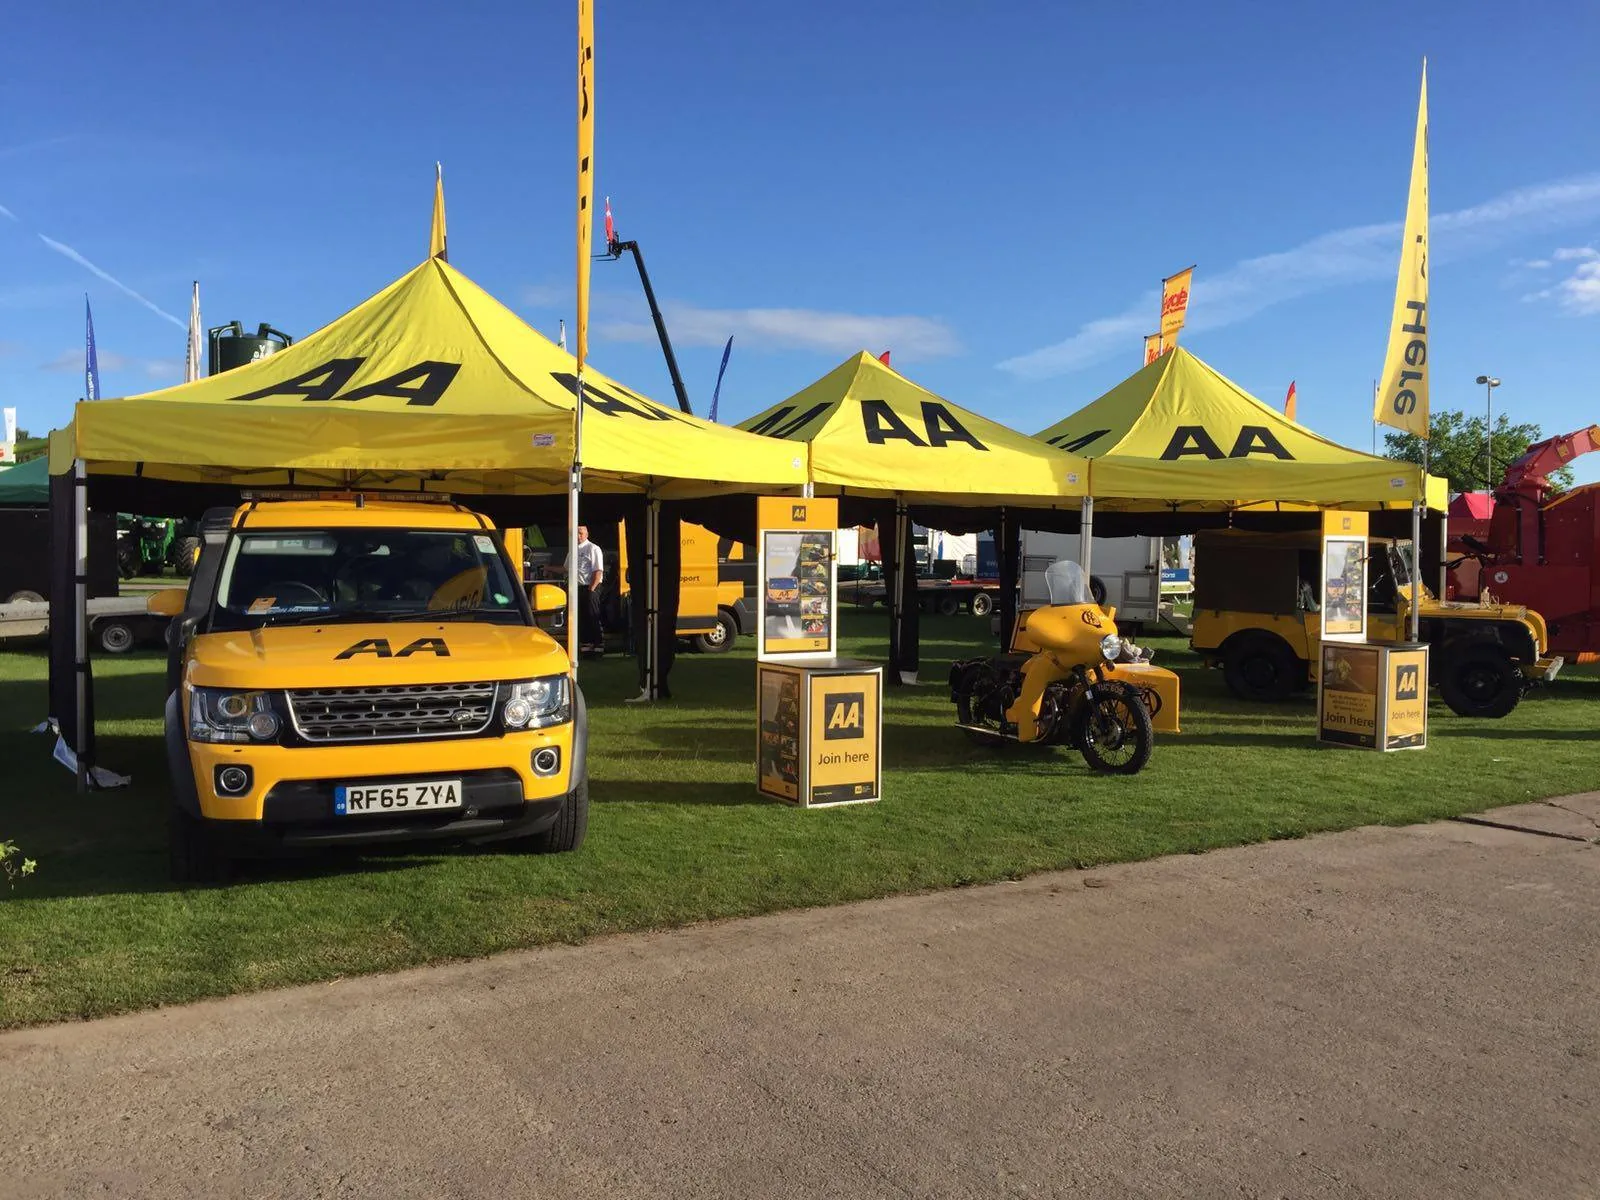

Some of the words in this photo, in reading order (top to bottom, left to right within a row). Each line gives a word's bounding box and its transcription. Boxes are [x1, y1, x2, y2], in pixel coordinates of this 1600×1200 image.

[225, 356, 462, 406] AA
[860, 400, 990, 452] AA
[1158, 425, 1297, 461] AA
[333, 638, 451, 660] AA
[1398, 672, 1416, 692] AA
[828, 702, 859, 729] AA
[1325, 711, 1346, 724] Join
[1350, 713, 1374, 728] here
[1391, 711, 1406, 720] Join
[1406, 710, 1420, 719] here
[818, 753, 841, 765] Join
[845, 752, 869, 763] here
[350, 788, 409, 810] RF65
[415, 785, 457, 806] ZYA
